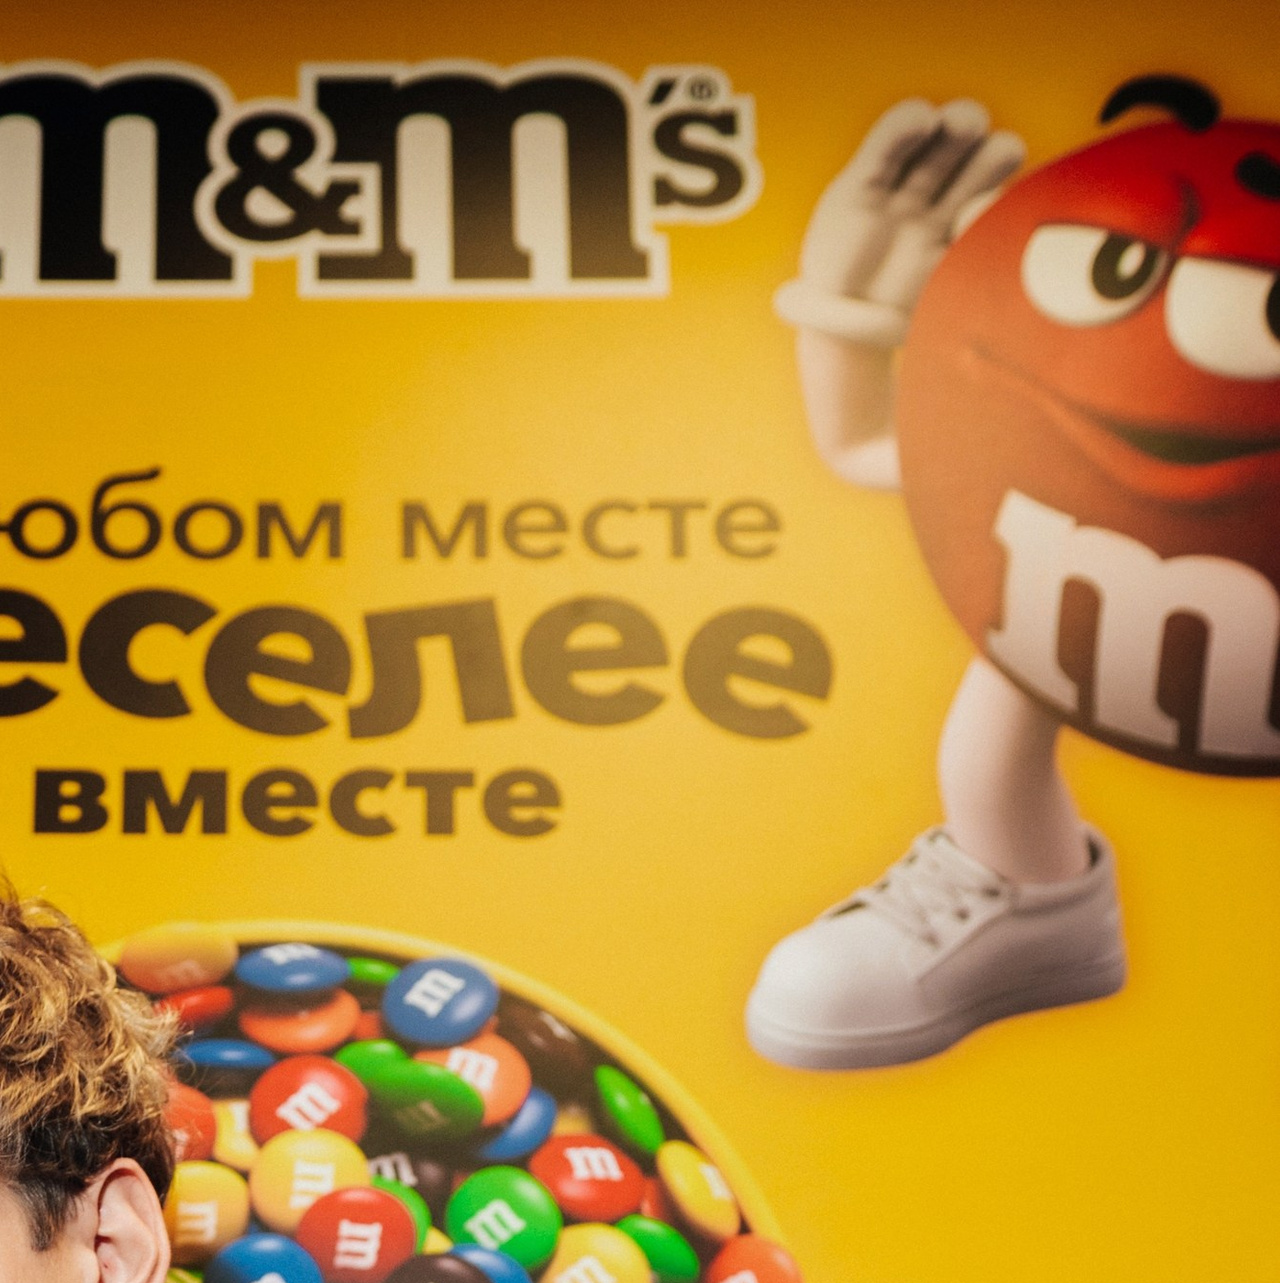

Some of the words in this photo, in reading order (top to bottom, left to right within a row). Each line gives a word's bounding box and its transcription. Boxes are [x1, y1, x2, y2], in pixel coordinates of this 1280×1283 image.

[400, 496, 784, 561] месте
[32, 766, 563, 837] вместе
[404, 969, 465, 1017] m
[276, 1082, 340, 1130] m
[564, 1147, 624, 1181] m
[335, 1219, 382, 1269] m
[464, 1199, 525, 1250] m
